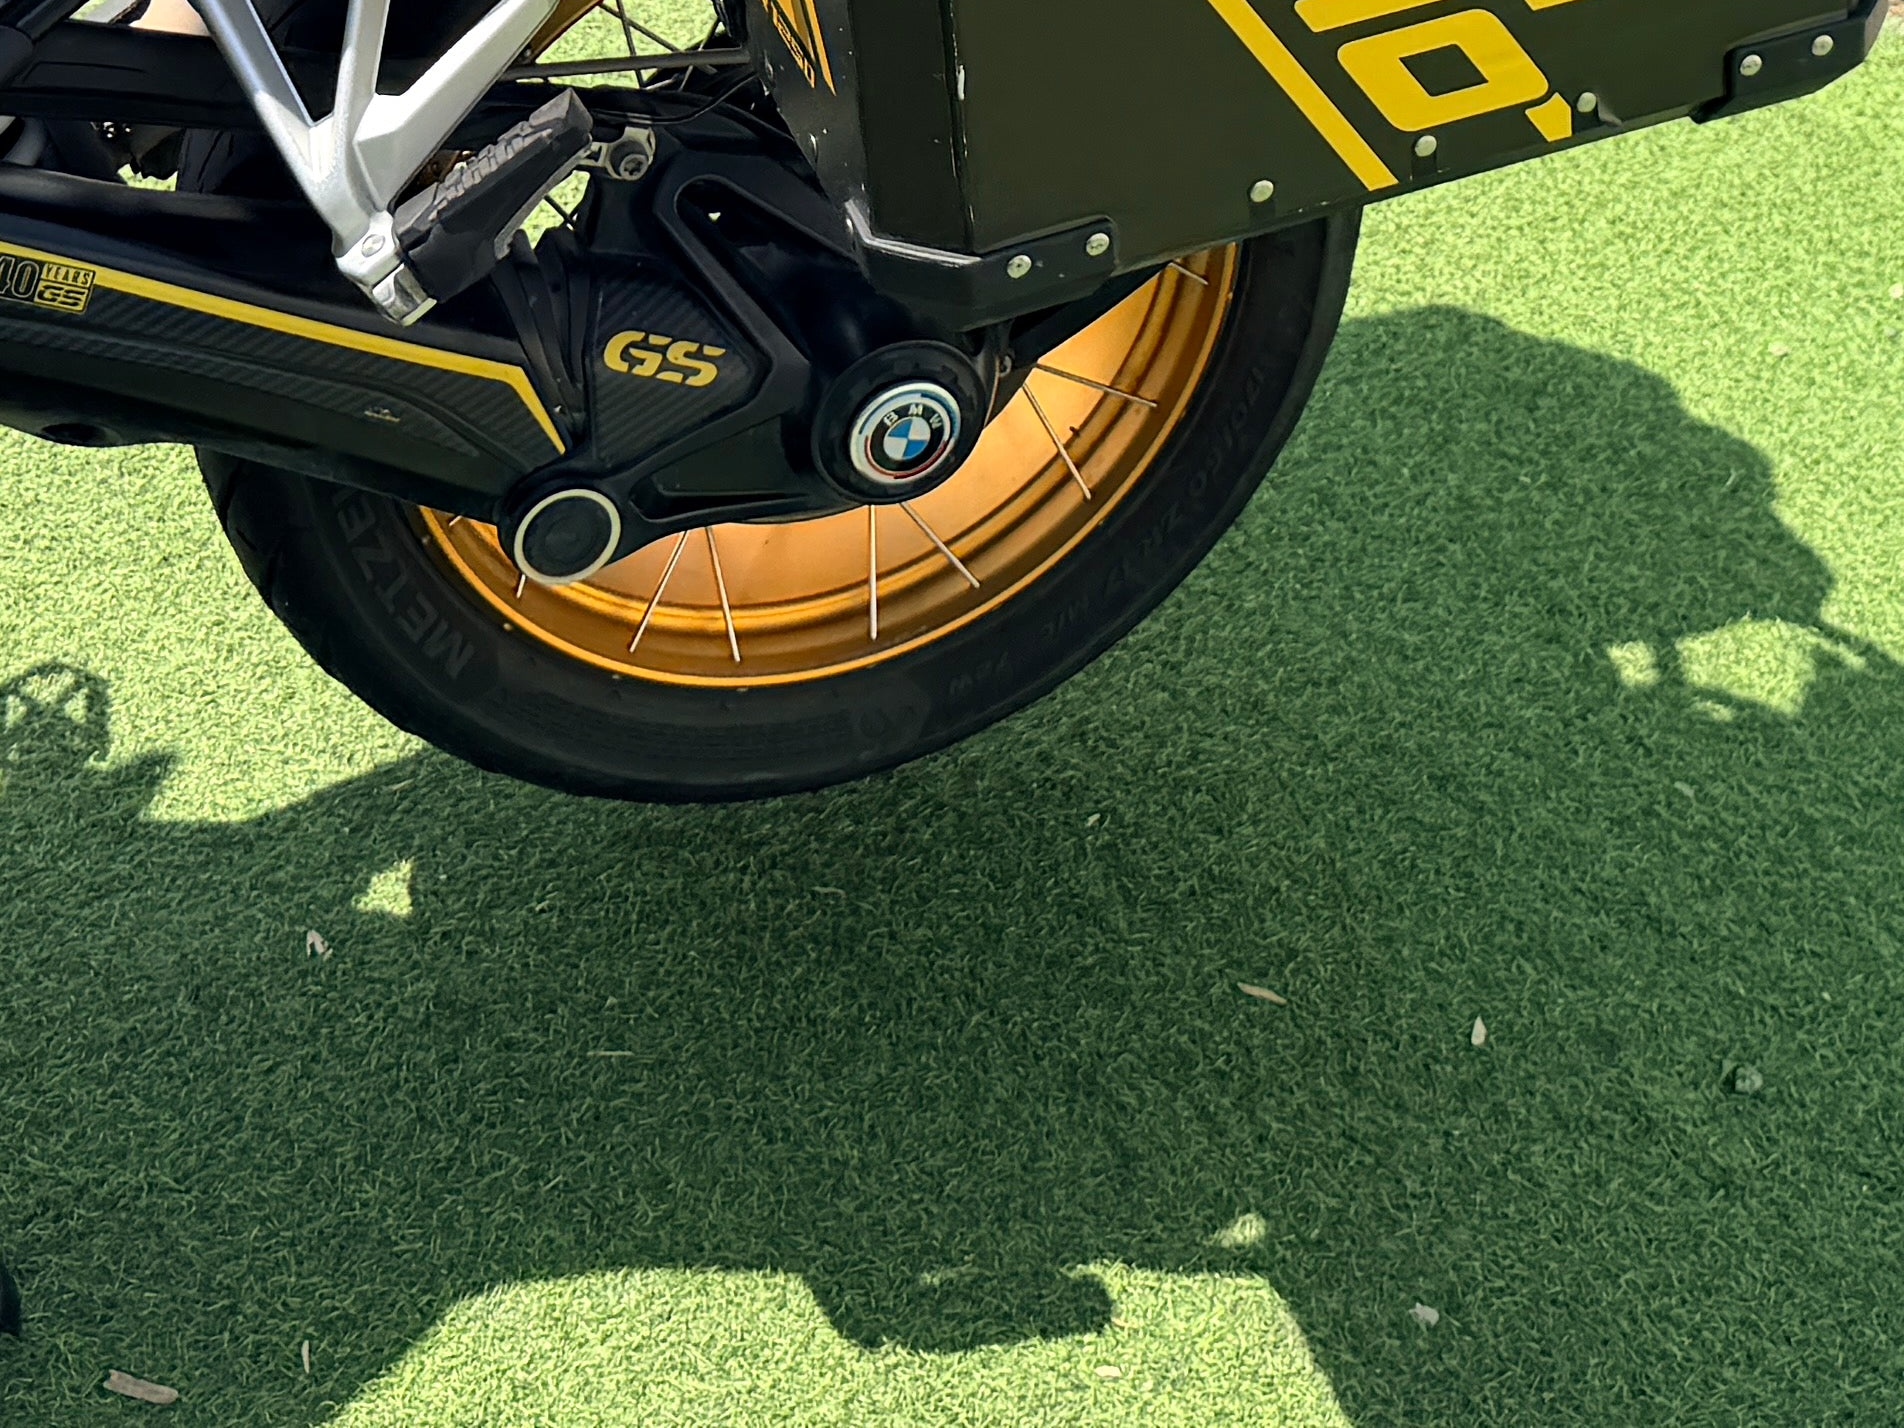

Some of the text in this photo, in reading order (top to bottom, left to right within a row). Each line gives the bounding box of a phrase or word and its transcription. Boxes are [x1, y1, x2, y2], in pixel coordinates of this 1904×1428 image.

[46, 264, 91, 285] YEARS
[37, 284, 86, 307] GS
[603, 330, 727, 387] GS
[883, 402, 943, 430] BMW
